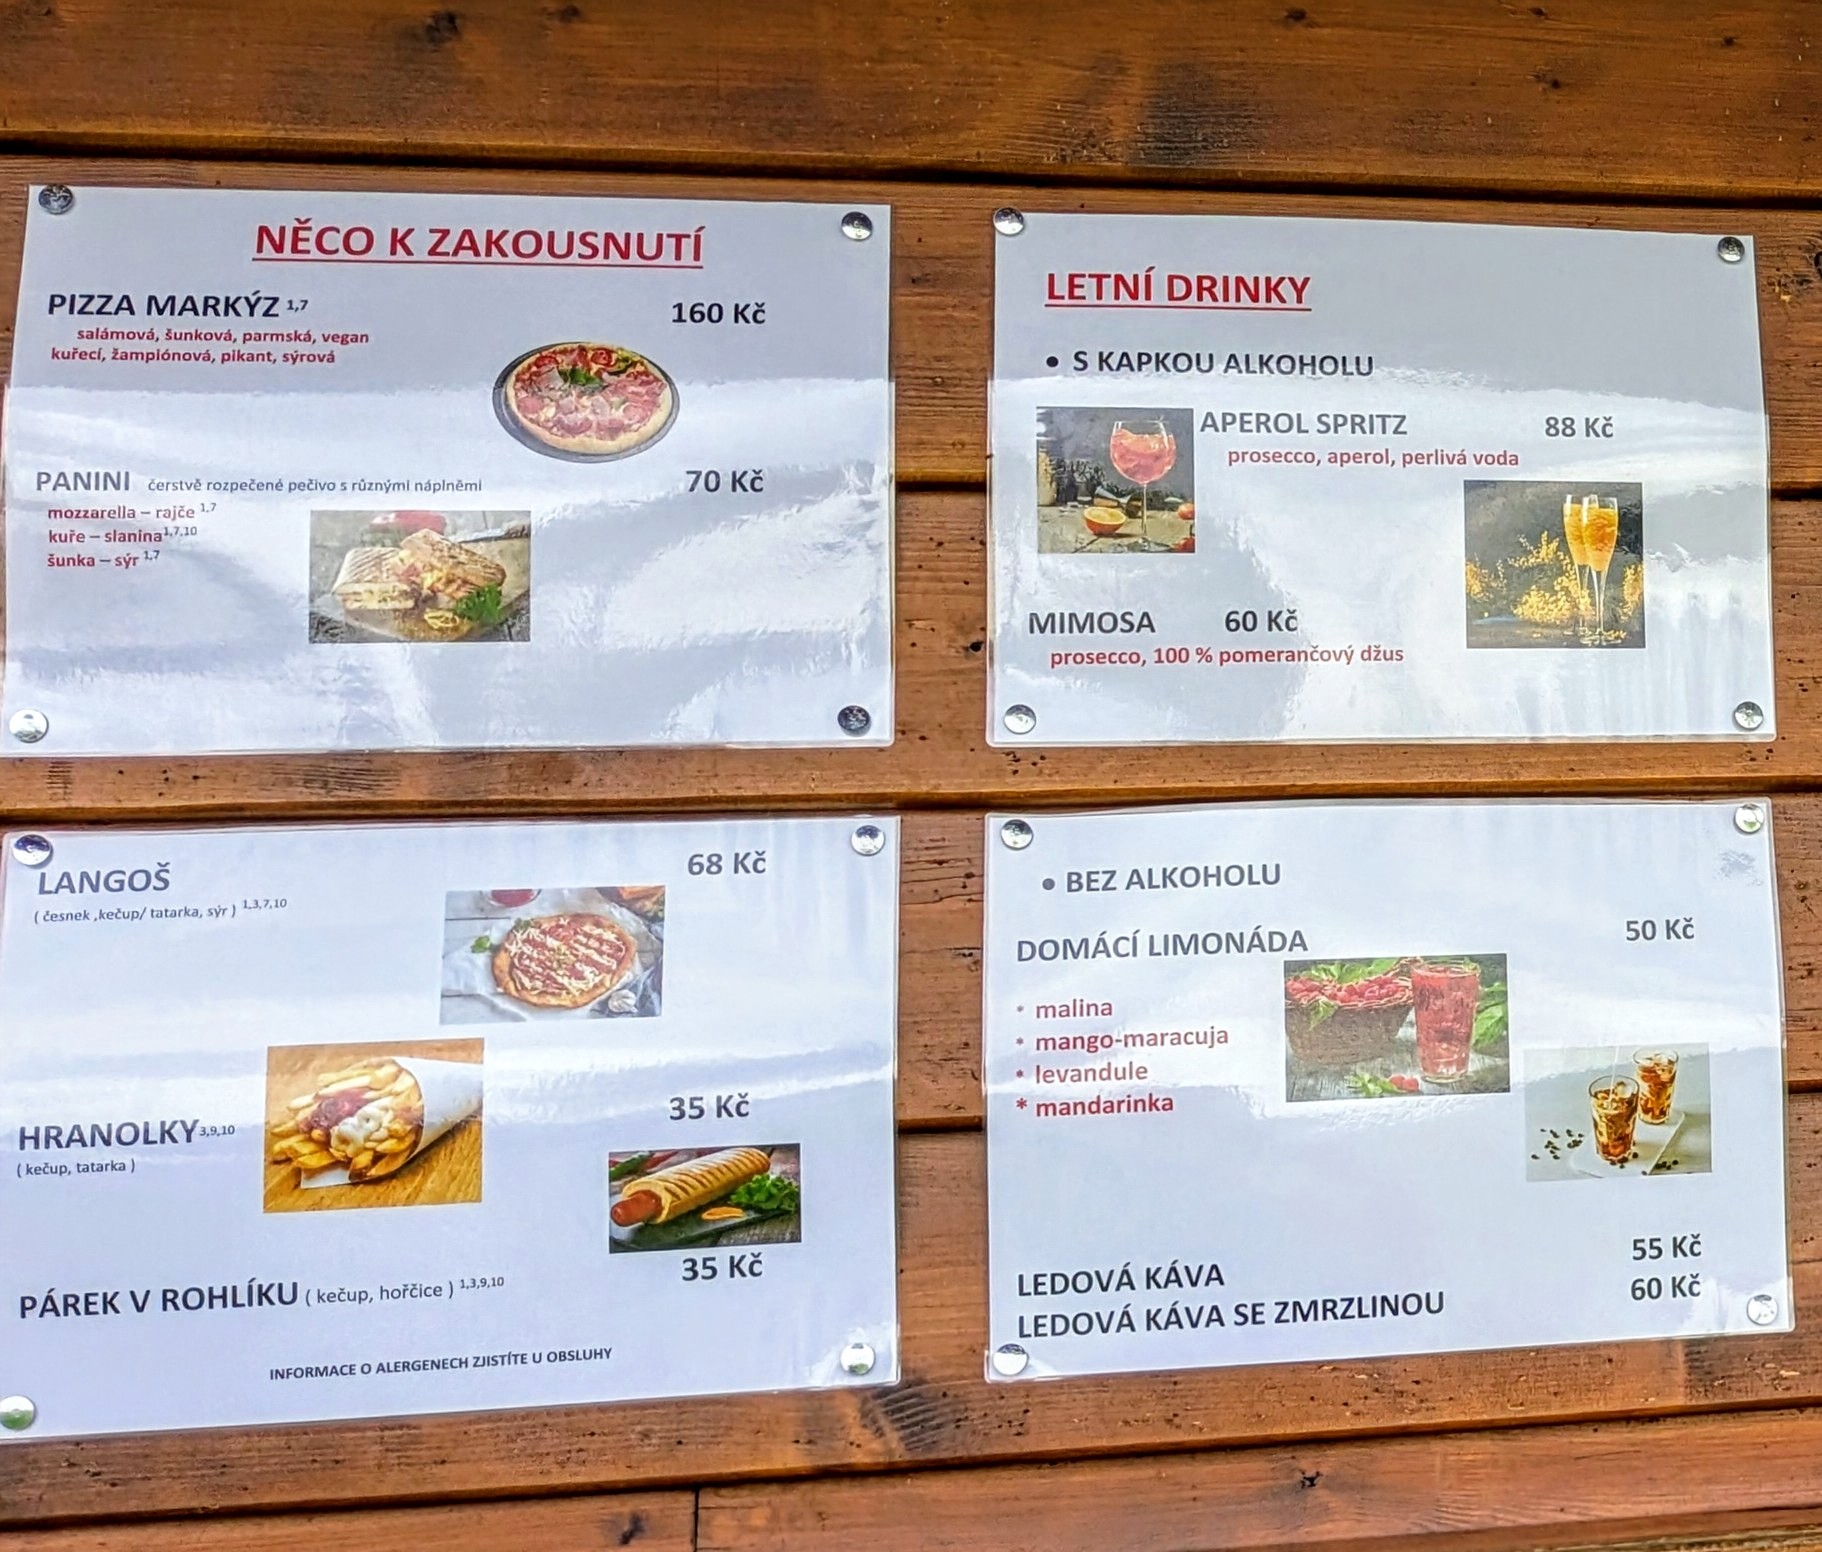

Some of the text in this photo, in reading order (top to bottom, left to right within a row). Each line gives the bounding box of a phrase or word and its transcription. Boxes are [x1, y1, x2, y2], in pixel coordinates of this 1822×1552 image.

[256, 218, 706, 263] NĚCO K ZAKOUSNUTÍ
[1047, 266, 1311, 305] LETNÍ DRINKY
[48, 294, 135, 315] PIZZA
[147, 290, 280, 317] MARKÝZ
[672, 301, 766, 324] 160 Kč
[77, 327, 369, 346] salámová, šunková, parmská, vegan
[51, 347, 335, 365] kuřecí, žampiónová, pikant, sýrová
[1073, 351, 1374, 377] S KAPKOU ALKOHOLU
[1199, 411, 1407, 435] APEROL SPRITZ
[1545, 417, 1614, 438] 88 Kč
[1228, 449, 1519, 468] prosecco, aperol, perlivá voda
[36, 471, 482, 496] PANINI čerstvě rozpečené pečivo s různými náplněmi
[686, 469, 764, 493] 70 Kč
[47, 505, 136, 520] mozzarella
[155, 505, 195, 523] rajče
[48, 530, 85, 544] kuře
[48, 553, 95, 568] šunka
[114, 553, 139, 570] sýr
[1028, 609, 1298, 634] MIMOSA 60 Kč
[1050, 645, 1403, 668] prosecco, 100 % pomerančový džus
[687, 850, 766, 875] 68 Kč
[38, 862, 170, 895] LANGOŠ
[1066, 863, 1280, 893] BEZ ALKOHOLU
[43, 908, 90, 921] česnek
[150, 906, 203, 919] tatarka,
[207, 903, 228, 918] sýr
[1626, 917, 1695, 941] 50 Kč
[1017, 925, 1308, 962] DOMÁCÍ LIMONÁDA
[1035, 1000, 1113, 1019] malina
[1035, 1026, 1229, 1054] mango-maracuja
[1035, 1063, 1148, 1084] levandule
[669, 1091, 751, 1120] 35 Kč
[1035, 1095, 1174, 1117] mandarinka
[26, 1162, 72, 1177] kečup,
[77, 1160, 126, 1174] tatarka
[1632, 1233, 1702, 1261] 55 Kč
[682, 1252, 763, 1281] 35 Kč
[1018, 1259, 1225, 1296] LEDOVÁ KÁVA
[19, 1288, 120, 1318] PÁREK
[129, 1290, 150, 1313] V
[162, 1278, 298, 1311] ROHLÍKU
[317, 1285, 374, 1305] kečup,
[380, 1282, 443, 1301] hořčice
[460, 1276, 504, 1290] 1,3,9,10
[1631, 1273, 1701, 1300] 60 Kč
[1018, 1291, 1444, 1338] LEDOVÁ KÁVA SE ZMRZLINOU
[269, 1347, 612, 1380] INFORMACE O ALERGENECH ZJISTÍTE U OBSLUHY
